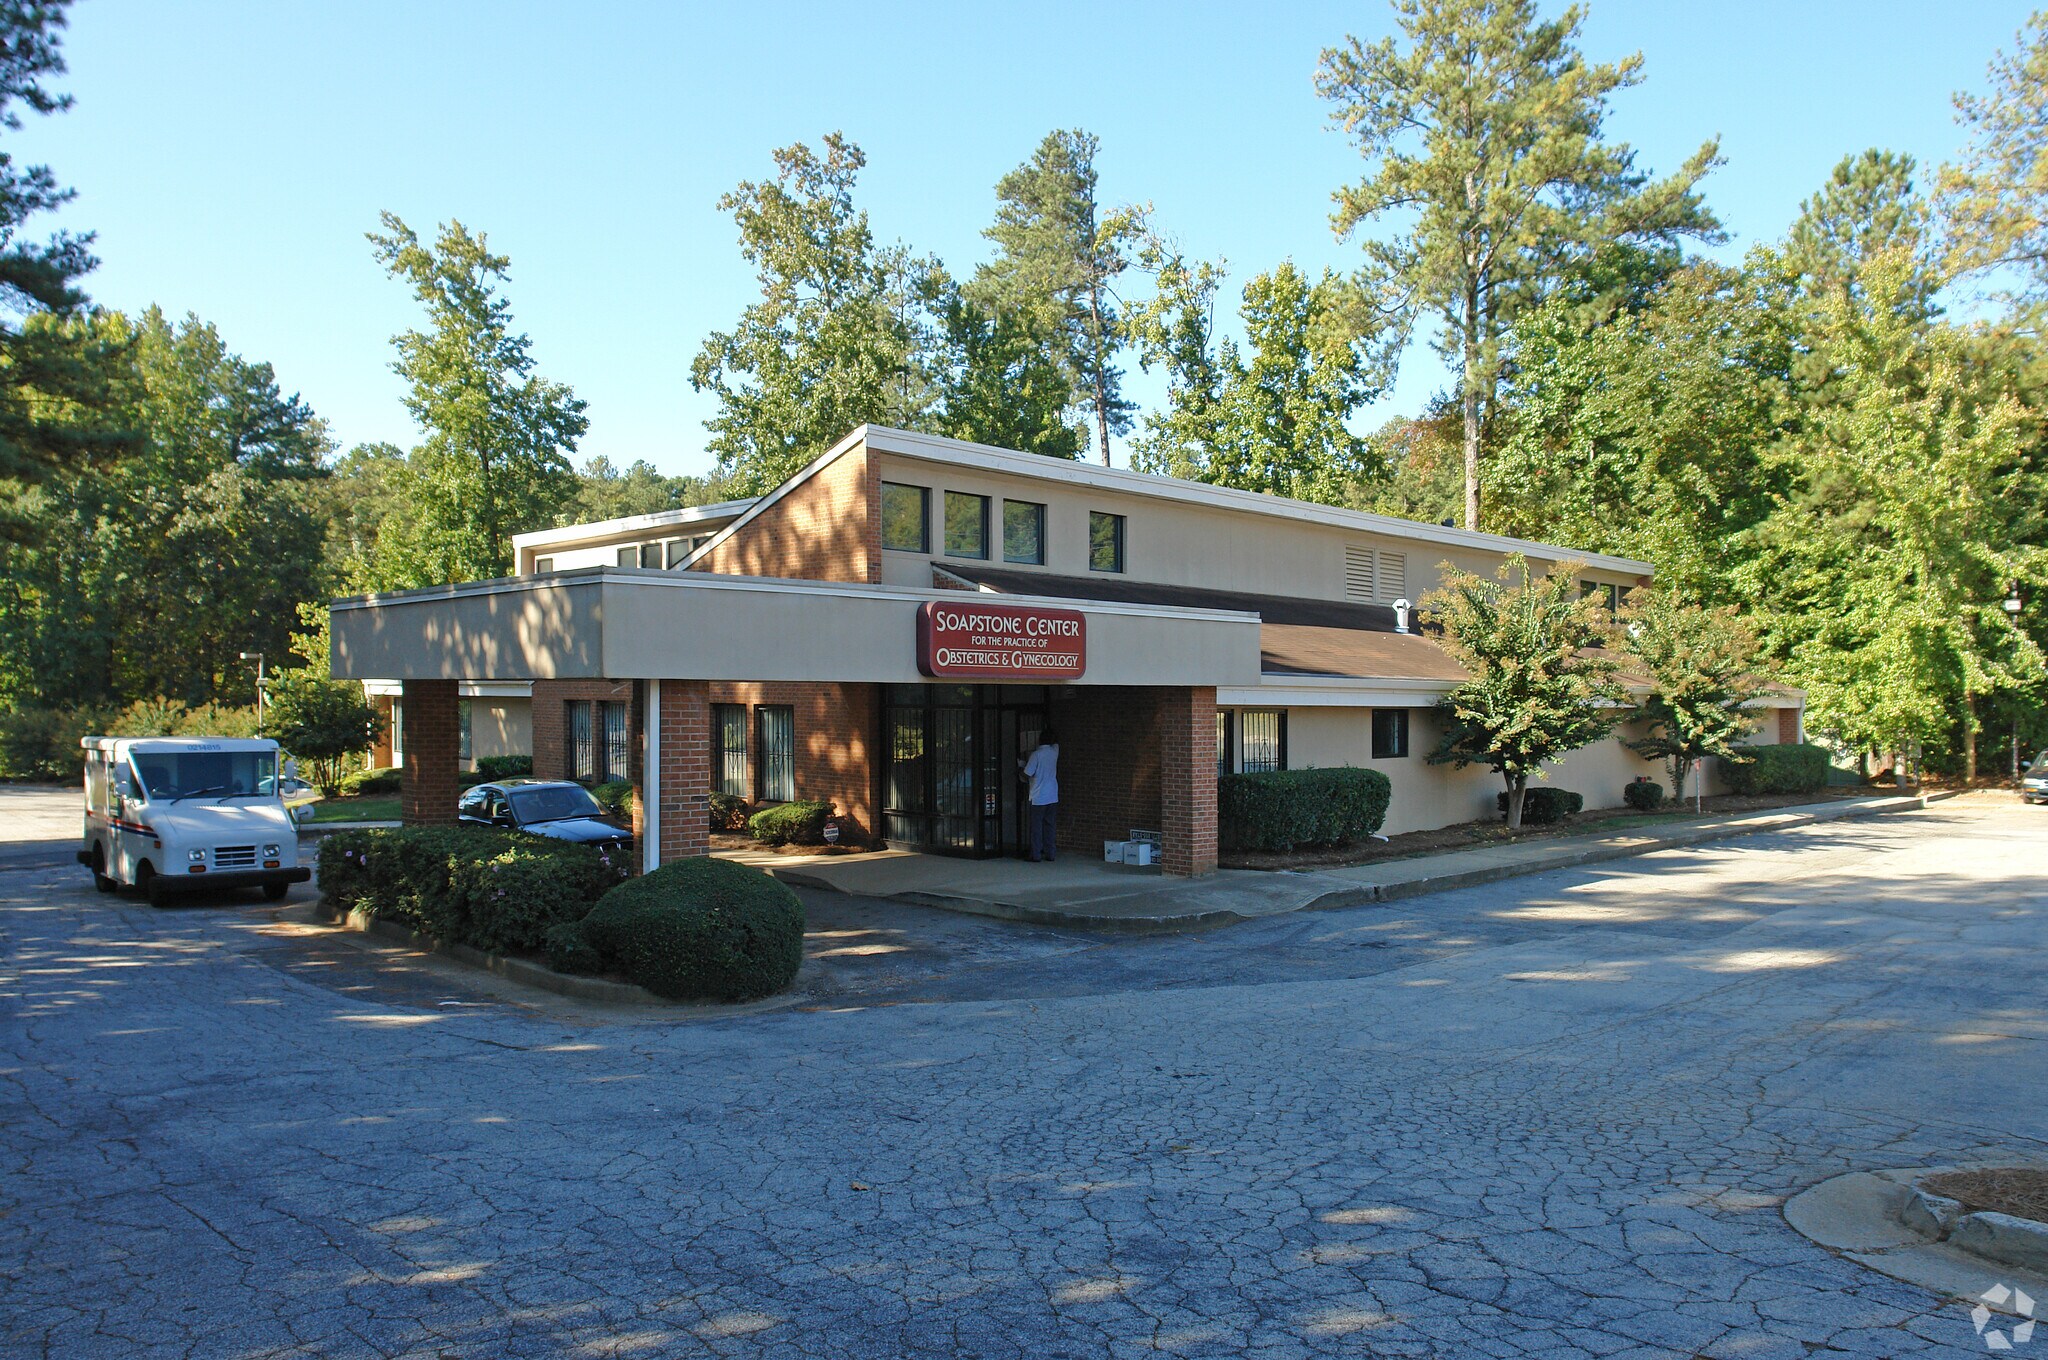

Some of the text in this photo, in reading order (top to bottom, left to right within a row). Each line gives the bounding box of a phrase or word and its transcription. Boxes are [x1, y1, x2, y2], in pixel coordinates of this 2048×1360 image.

[936, 611, 1079, 637] SOAPSTONE CENTER
[971, 635, 1048, 648] FOR THE PRACTICE OF
[936, 647, 1079, 669] OBSTETRICS & GYNECOLOGY
